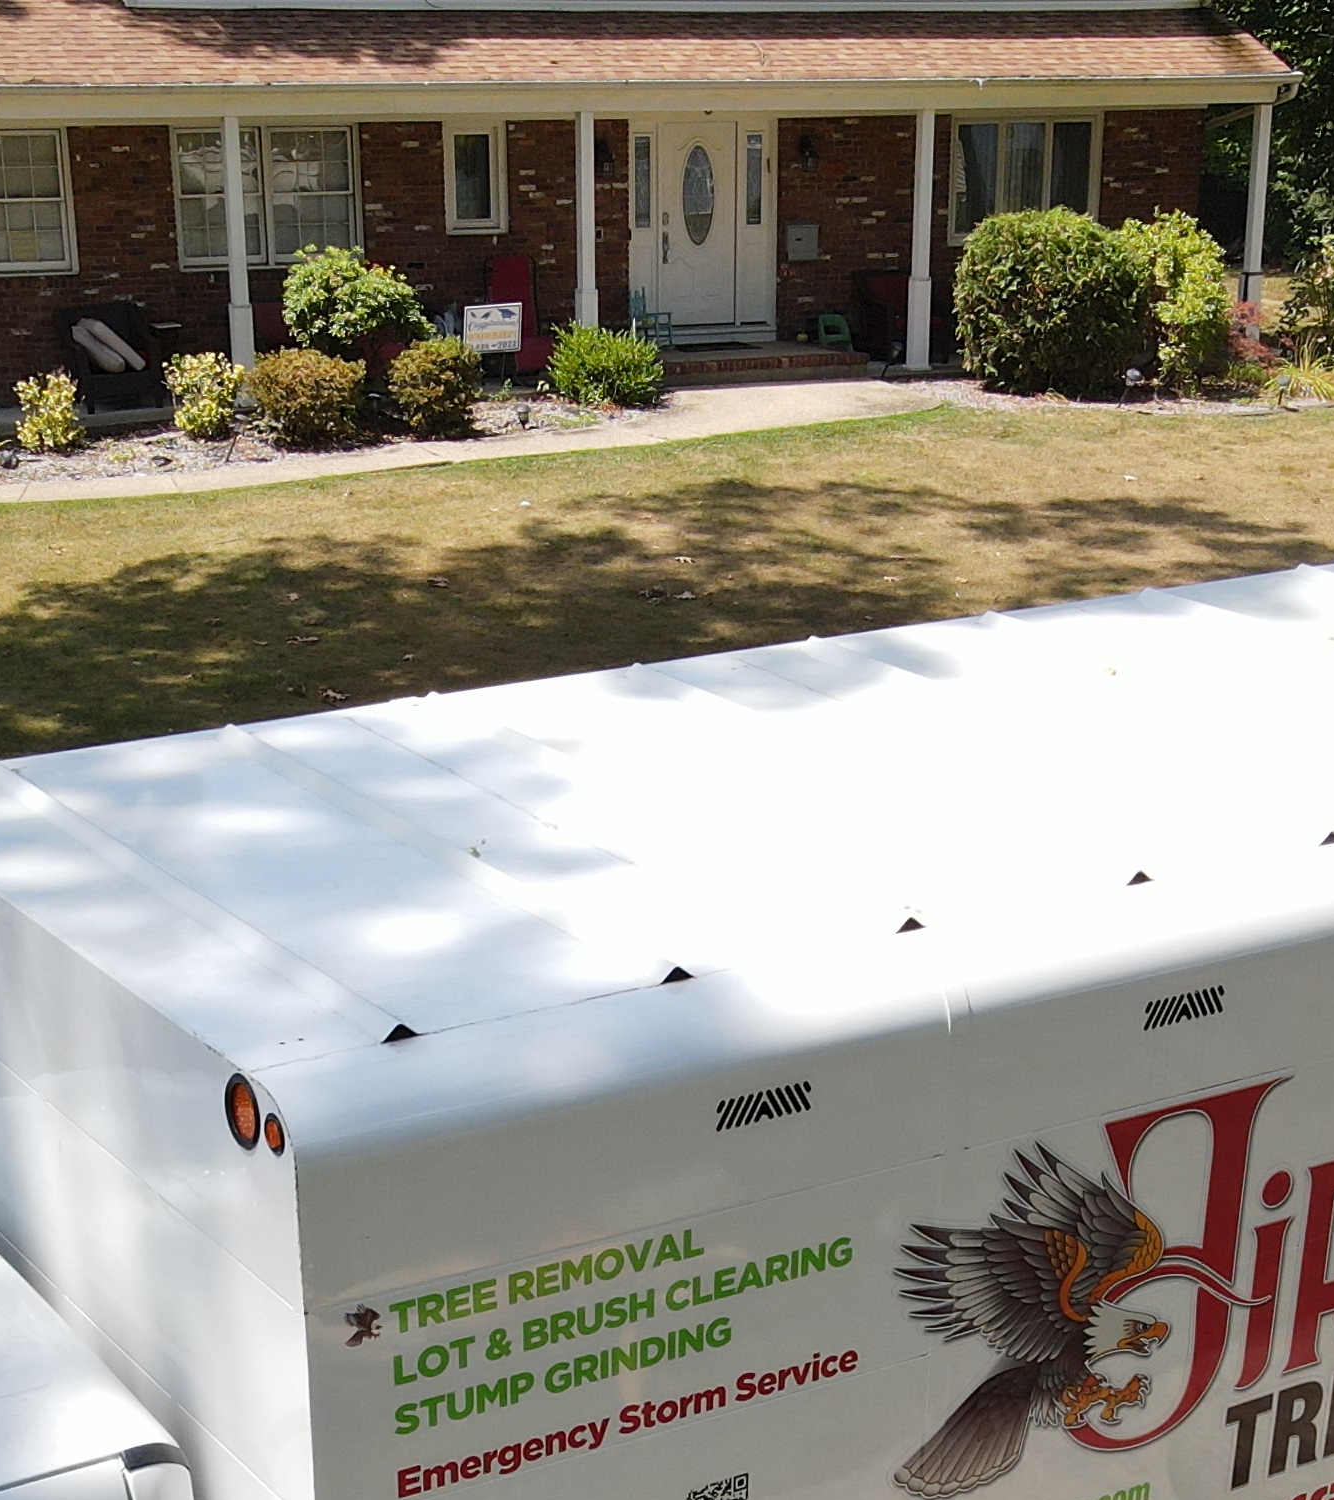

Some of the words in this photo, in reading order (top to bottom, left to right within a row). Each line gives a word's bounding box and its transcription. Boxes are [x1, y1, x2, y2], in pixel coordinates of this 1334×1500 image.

[389, 1279, 497, 1335] TREE
[508, 1228, 705, 1305] REMOVAL
[393, 1336, 477, 1387] LOT
[485, 1327, 513, 1361] &
[523, 1289, 655, 1354] BRUSH
[666, 1237, 855, 1312] CLEARING
[394, 1372, 535, 1436] STUMP
[544, 1316, 733, 1395] GRINDING
[397, 1417, 610, 1499] Emergency
[618, 1385, 726, 1436] Storm
[735, 1347, 859, 1402] Service
